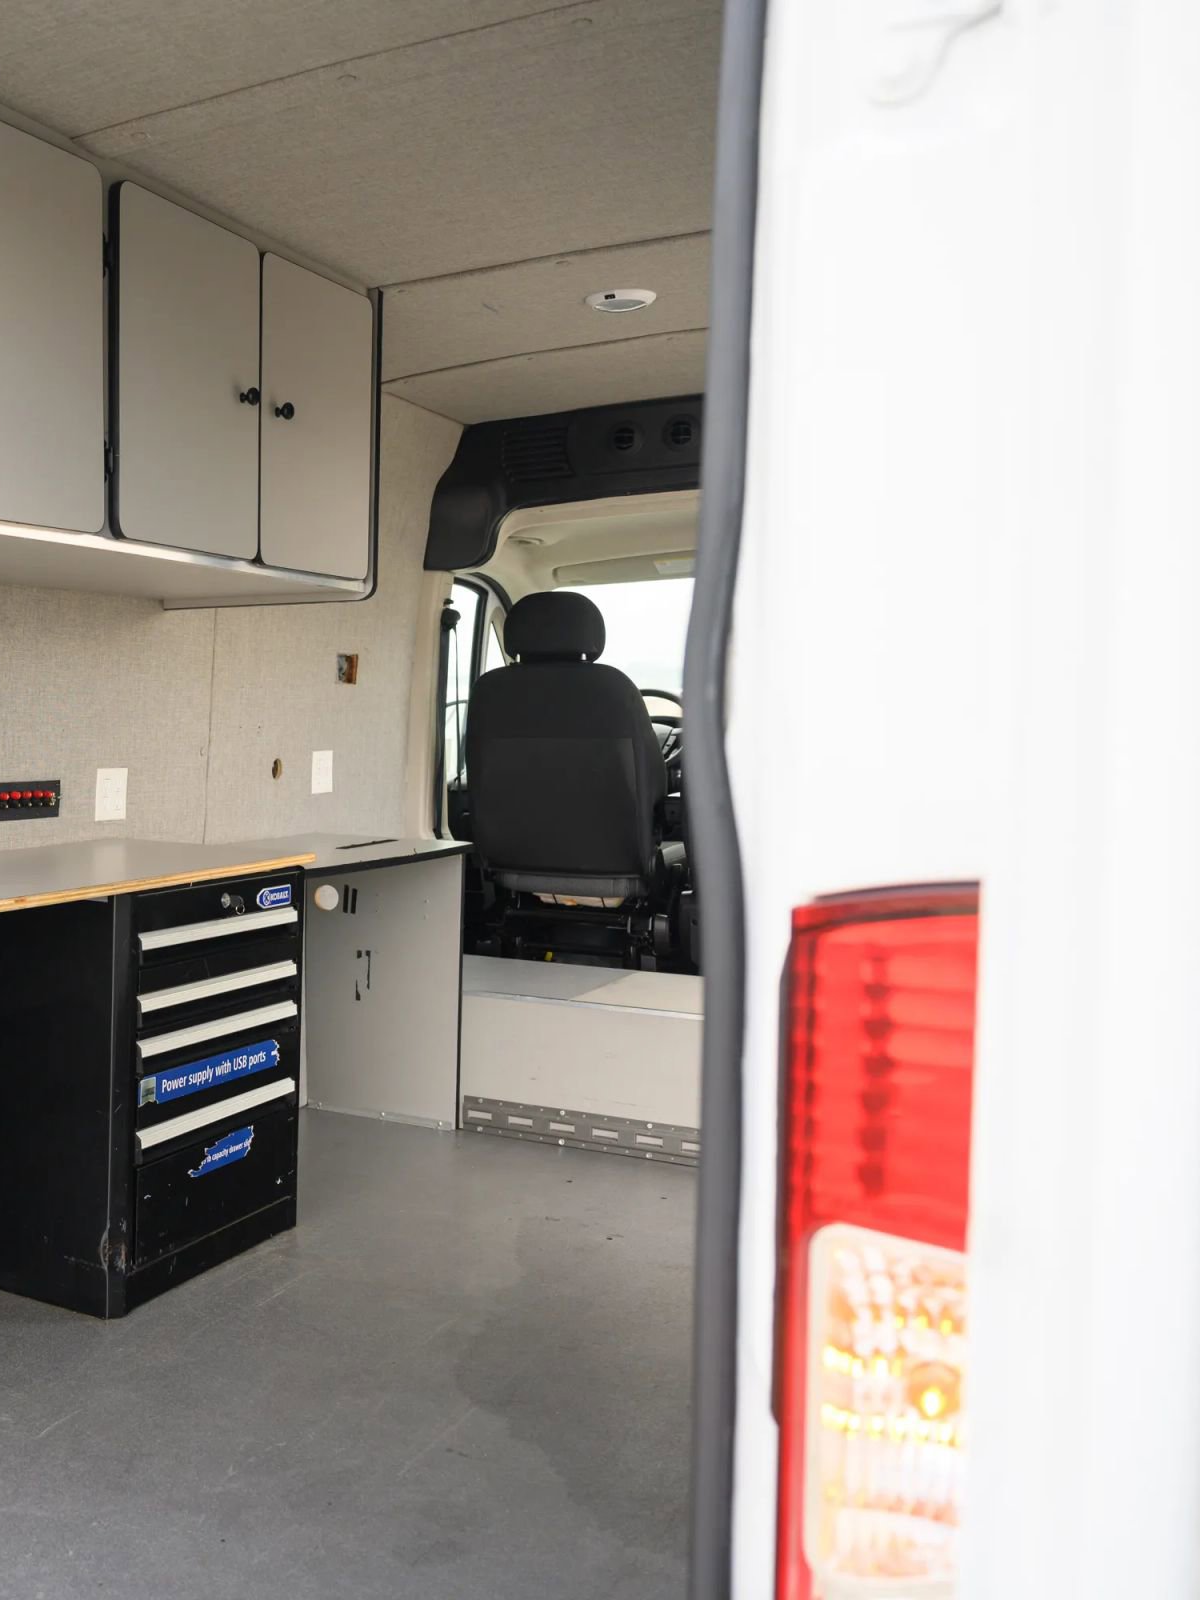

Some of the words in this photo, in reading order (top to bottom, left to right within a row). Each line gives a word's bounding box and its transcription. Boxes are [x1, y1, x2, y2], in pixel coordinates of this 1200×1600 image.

[161, 1076, 186, 1093] Power
[188, 1066, 213, 1087] supply
[215, 1060, 231, 1076] with
[233, 1055, 247, 1071] USB
[248, 1050, 266, 1069] ports
[211, 1148, 228, 1161] capacity
[229, 1144, 243, 1154] drawer
